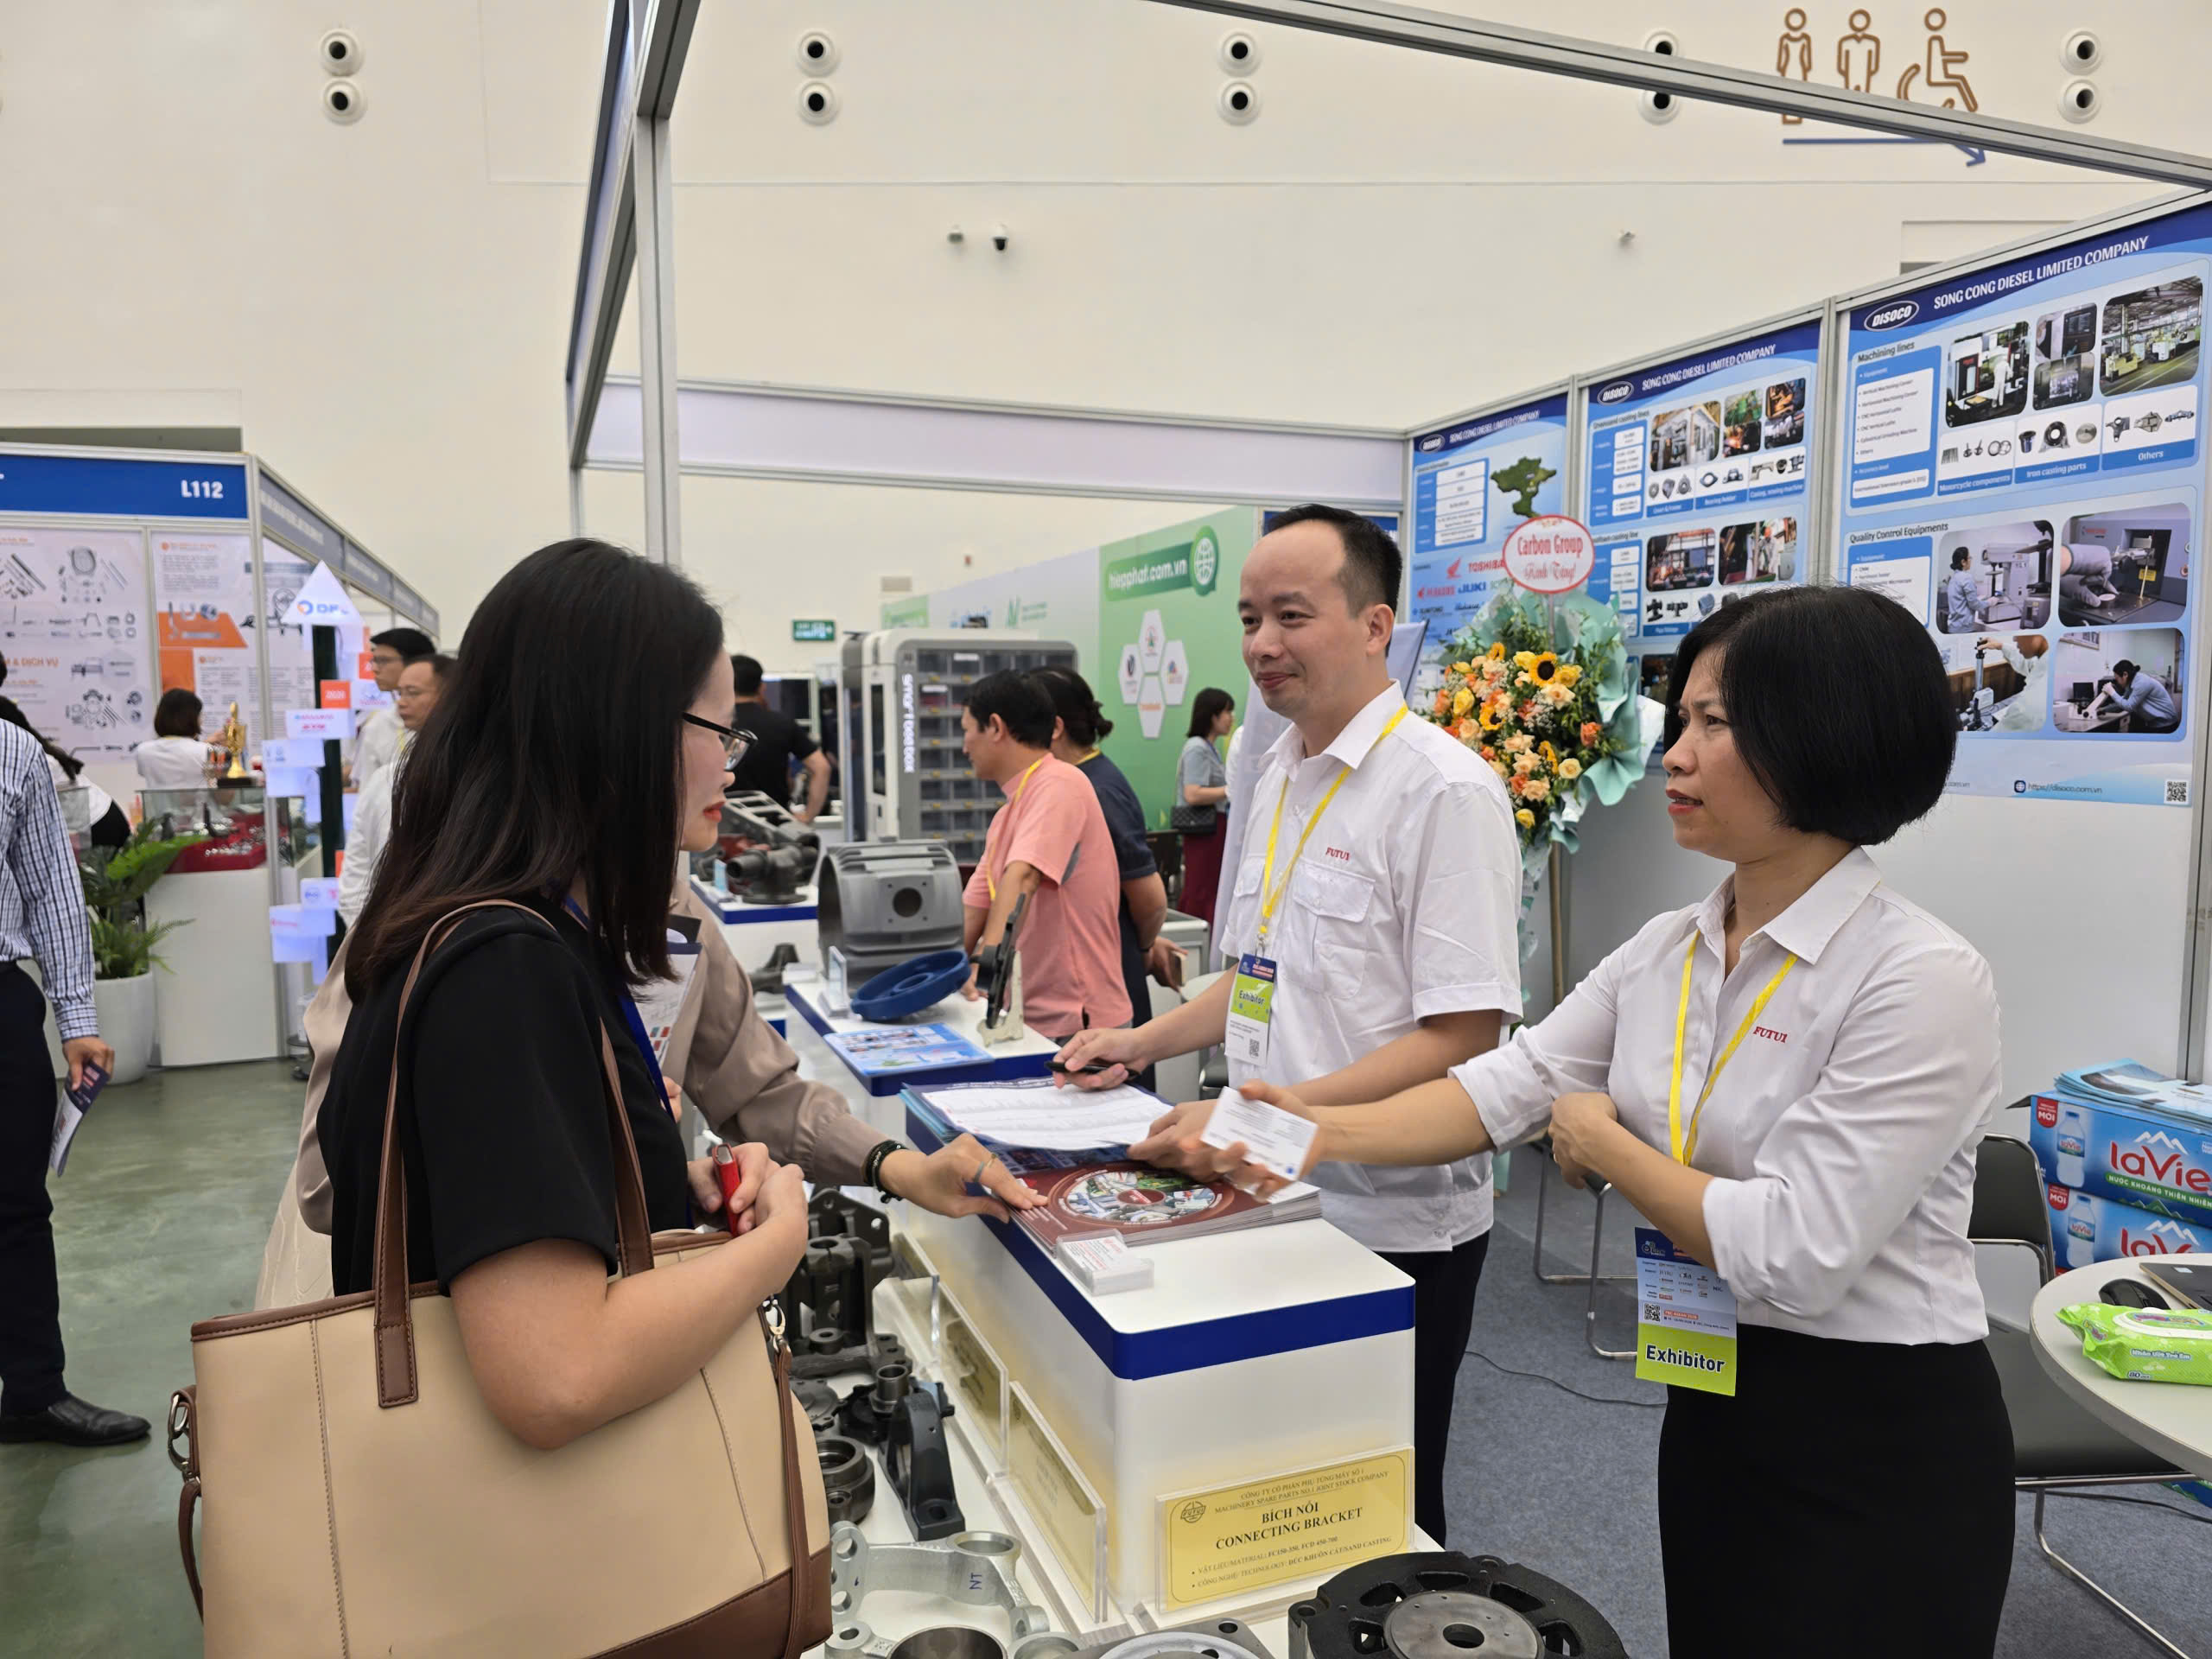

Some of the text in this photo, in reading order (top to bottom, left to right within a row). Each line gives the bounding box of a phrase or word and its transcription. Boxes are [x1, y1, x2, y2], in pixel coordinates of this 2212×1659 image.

[1934, 235, 2150, 310] SONG CONG DIESEL LIMITED COMPANY
[1872, 303, 1913, 327] DISOCO
[1858, 341, 1915, 362] Machining lines
[1642, 344, 1777, 391] SONG CONG DIESEL LIMITED COMPANY
[2138, 450, 2164, 461] Others
[2042, 467, 2067, 476] casting
[2067, 463, 2087, 474] parts
[181, 480, 224, 499] L112
[1850, 523, 1948, 543] Quality Control Equipments
[1517, 534, 1584, 558] Carbon Group
[1239, 989, 1264, 1005] Exhibitor
[1646, 1344, 1726, 1373] Exhibitor
[1215, 1500, 1255, 1514] MACHINERY
[1256, 1495, 1277, 1504] SPARE
[1278, 1490, 1299, 1500] PARTS
[1316, 1483, 1334, 1493] JOINT
[1335, 1478, 1355, 1489] STOCK
[1357, 1471, 1389, 1484] COMPANY
[1241, 1490, 1260, 1500] CÔNG
[1262, 1499, 1319, 1523] BÍCH NỐI
[1216, 1506, 1363, 1550] CONNECTING BRACKET
[1363, 1535, 1391, 1549] CASTING
[969, 1572, 982, 1590] NT
